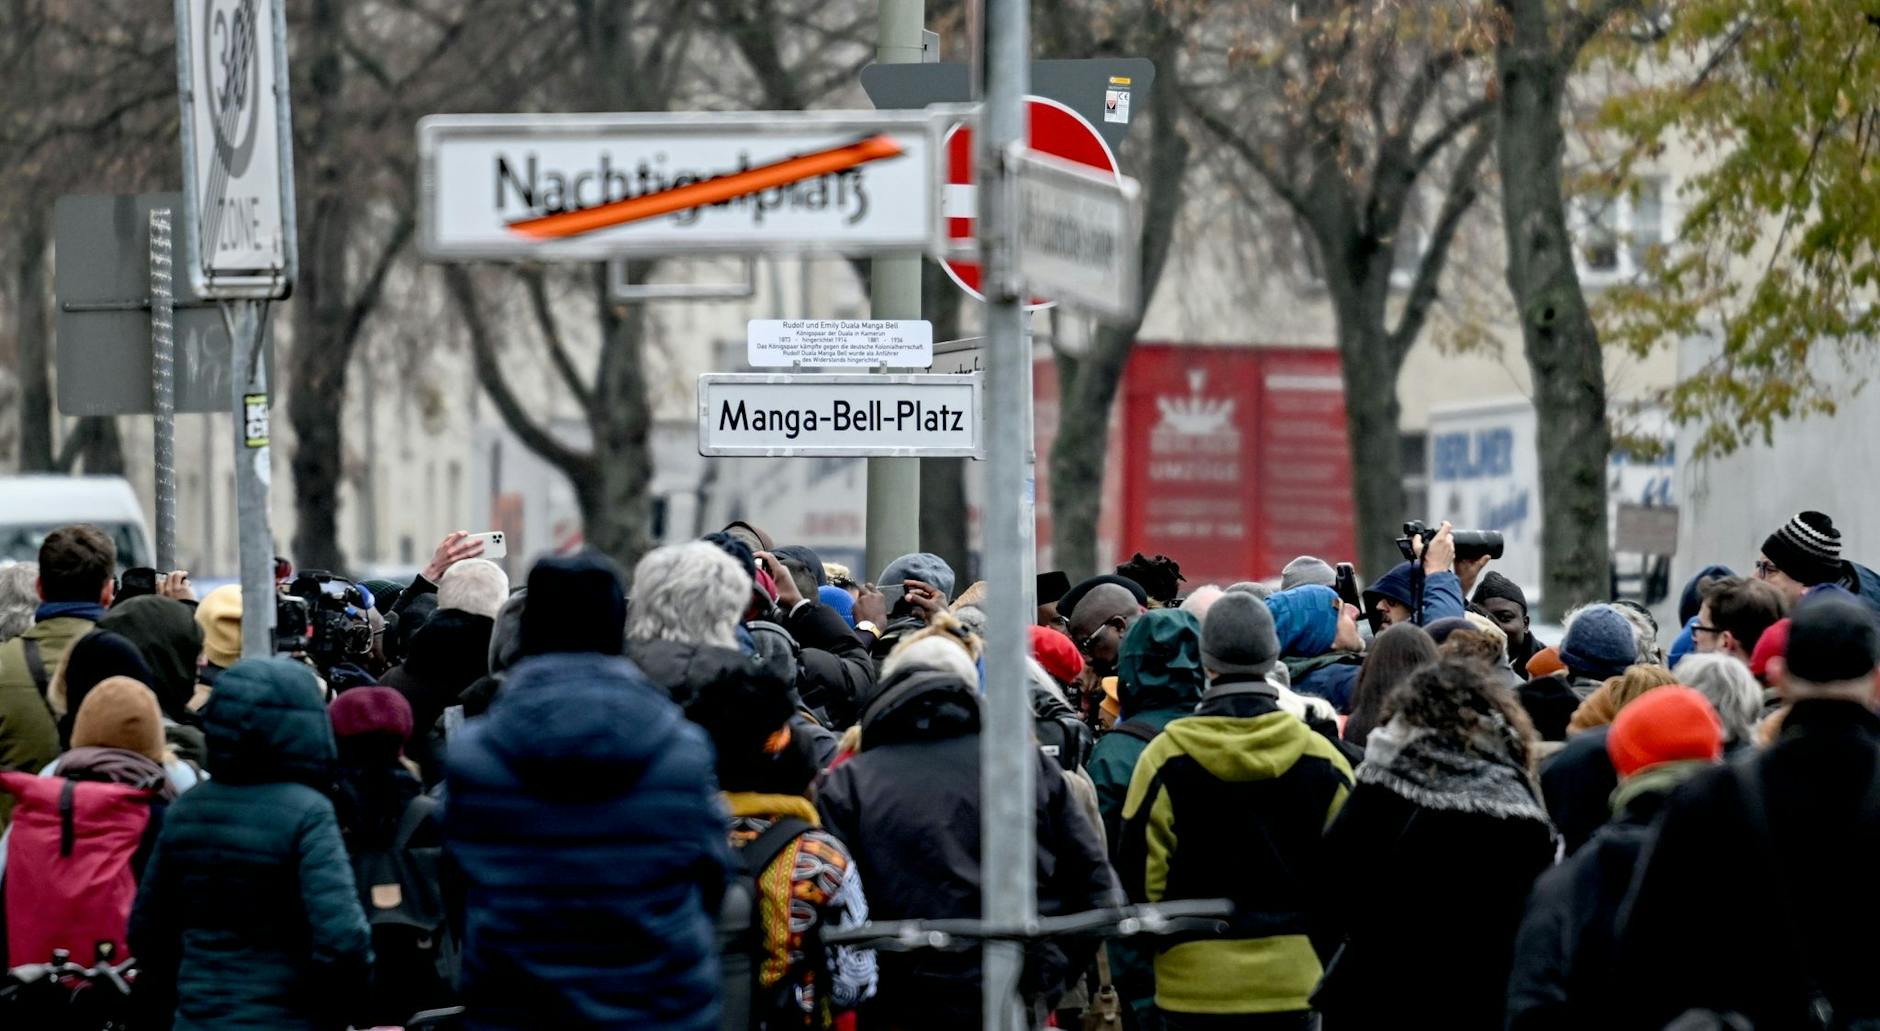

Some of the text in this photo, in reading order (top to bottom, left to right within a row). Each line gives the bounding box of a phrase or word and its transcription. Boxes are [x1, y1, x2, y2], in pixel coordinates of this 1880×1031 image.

[217, 197, 261, 251] ZONE
[782, 321, 899, 331] Rudolf und Emily Duala Manga Bell
[796, 330, 827, 338] Königspaar
[768, 343, 799, 351] Königspaar
[800, 343, 822, 351] kämpfte
[817, 350, 836, 358] Manga
[719, 399, 964, 440] Manga-Bell-Platz
